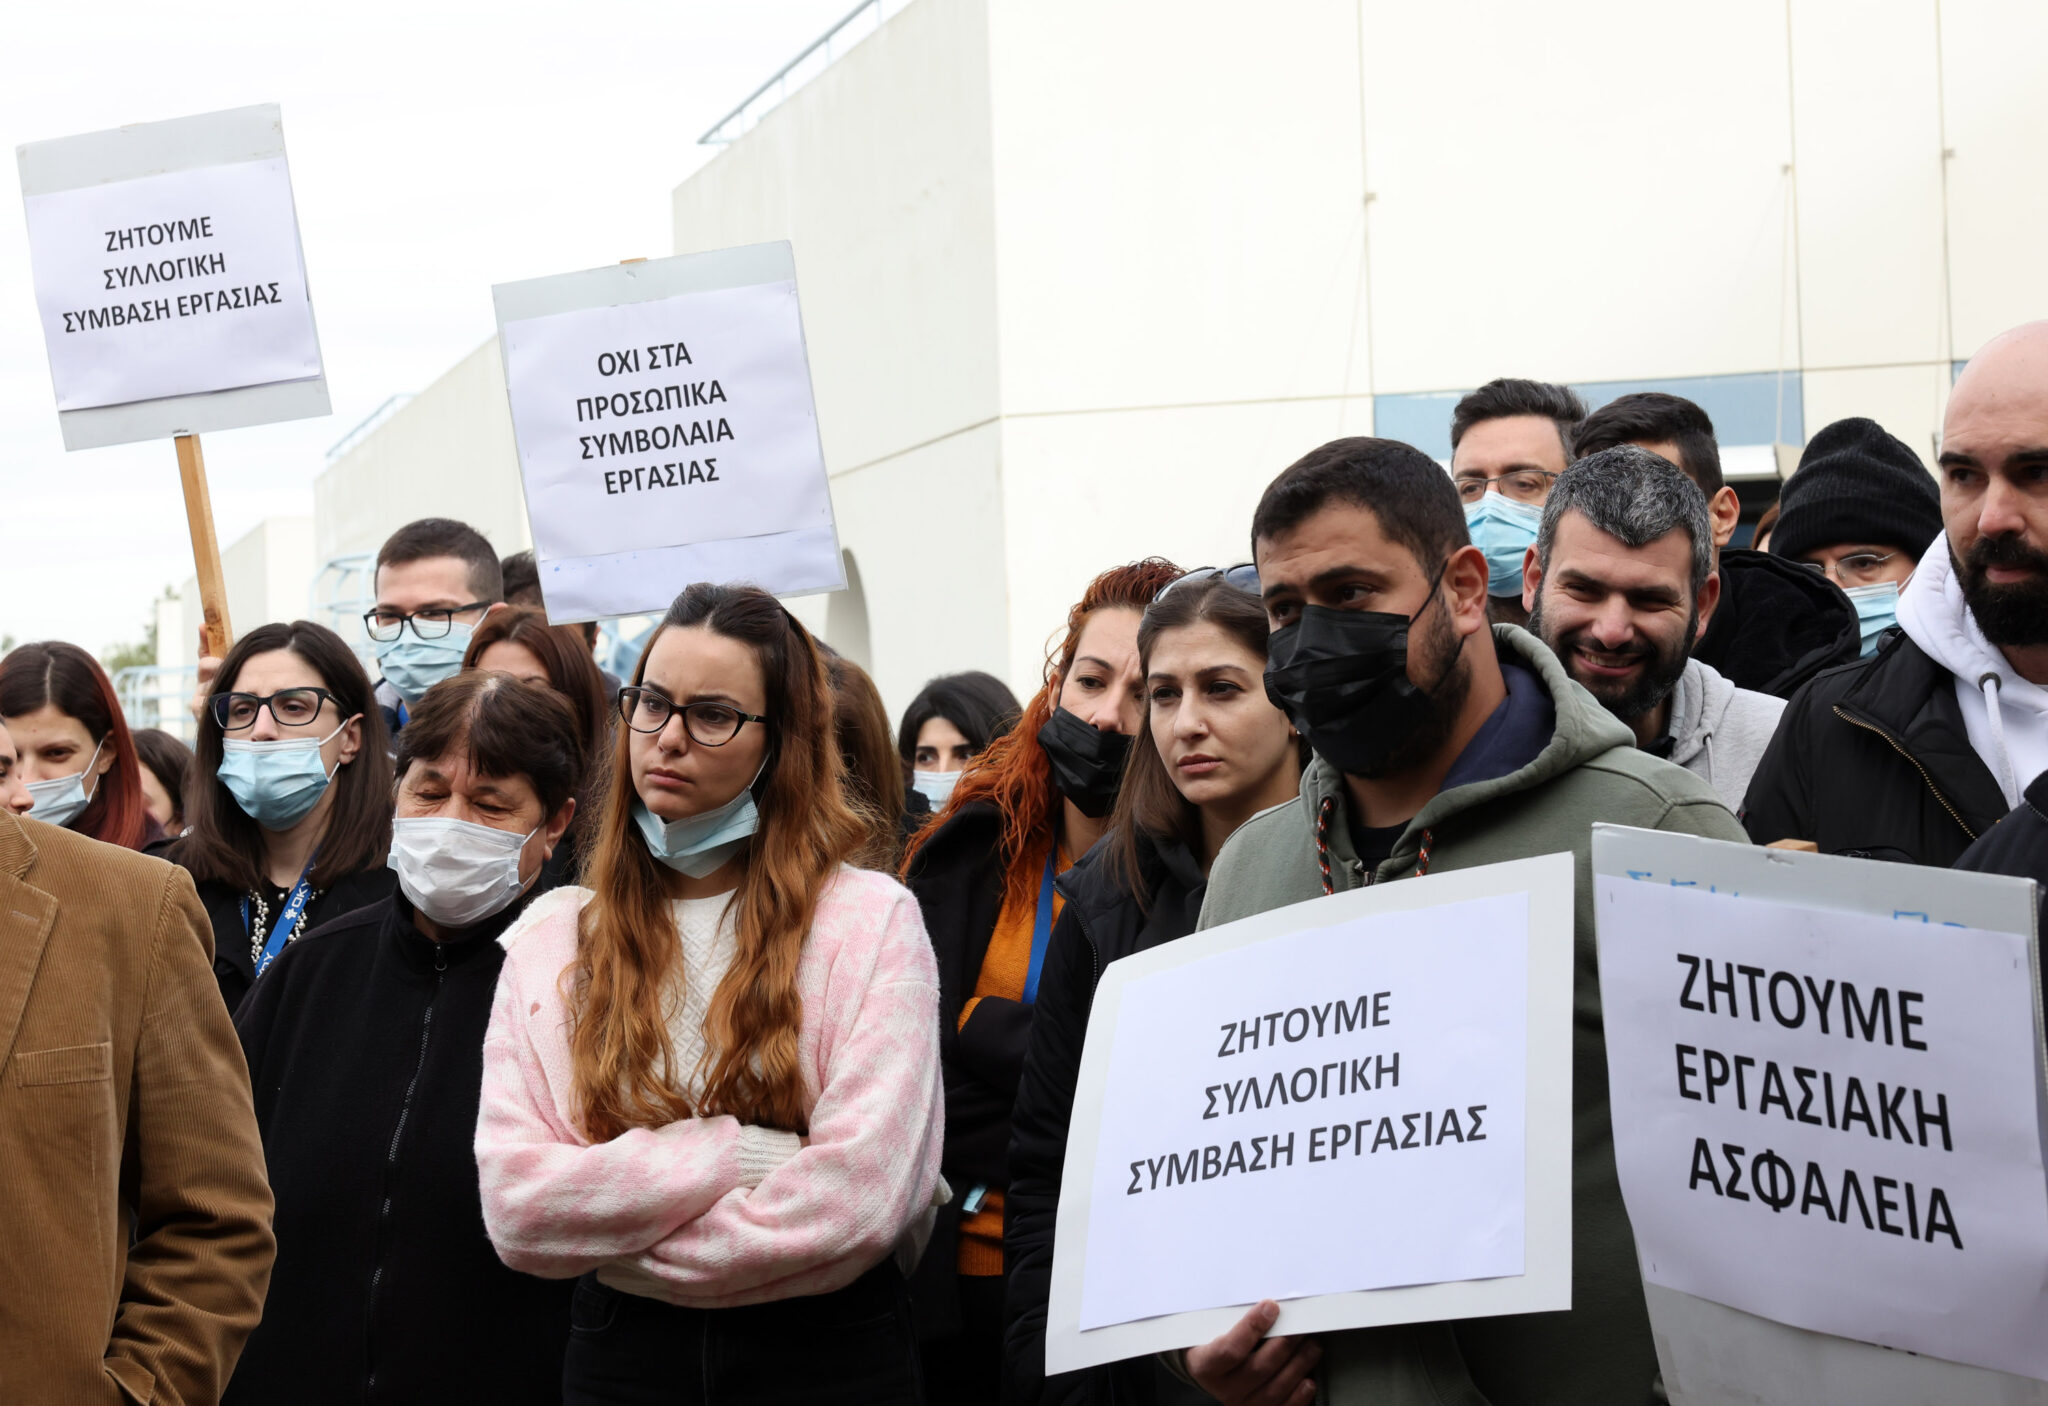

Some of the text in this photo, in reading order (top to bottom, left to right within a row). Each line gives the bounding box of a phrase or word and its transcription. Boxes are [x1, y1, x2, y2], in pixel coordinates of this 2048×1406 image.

[104, 216, 214, 253] ΖΗΤΟΥΜΕ
[103, 252, 226, 290] ΣΥΛΛΟΓΙΚΗ
[62, 282, 282, 334] ΣΥΜΒΑΣΗ ΕΡΓΑΣΙΑΣ
[597, 342, 693, 377] ΟΧΙ ΣΤΑ
[576, 379, 728, 422] ΠΡΟΣΩΠΙΚΑ
[579, 417, 735, 460] ΣΥΜΒΟΛΑΙΑ
[604, 457, 720, 495] ΕΡΓΑΣΙΑΣ
[1217, 991, 1391, 1058] ΖΗΤΟΥΜΕ
[1677, 953, 1928, 1052] ΖΗΤΟΥΜΕ
[1202, 1051, 1400, 1121] ΣΥΛΛΟΓΙΚΗ
[1675, 1043, 1953, 1152] ΕΡΓΑΣΙΑΚΗ
[1126, 1104, 1488, 1196] ΣΥΜΒΑΣΗ ΕΡΓΑΣΙΑΣ
[1689, 1137, 1964, 1251] ΑΣΦΑΛΕΙΑ
